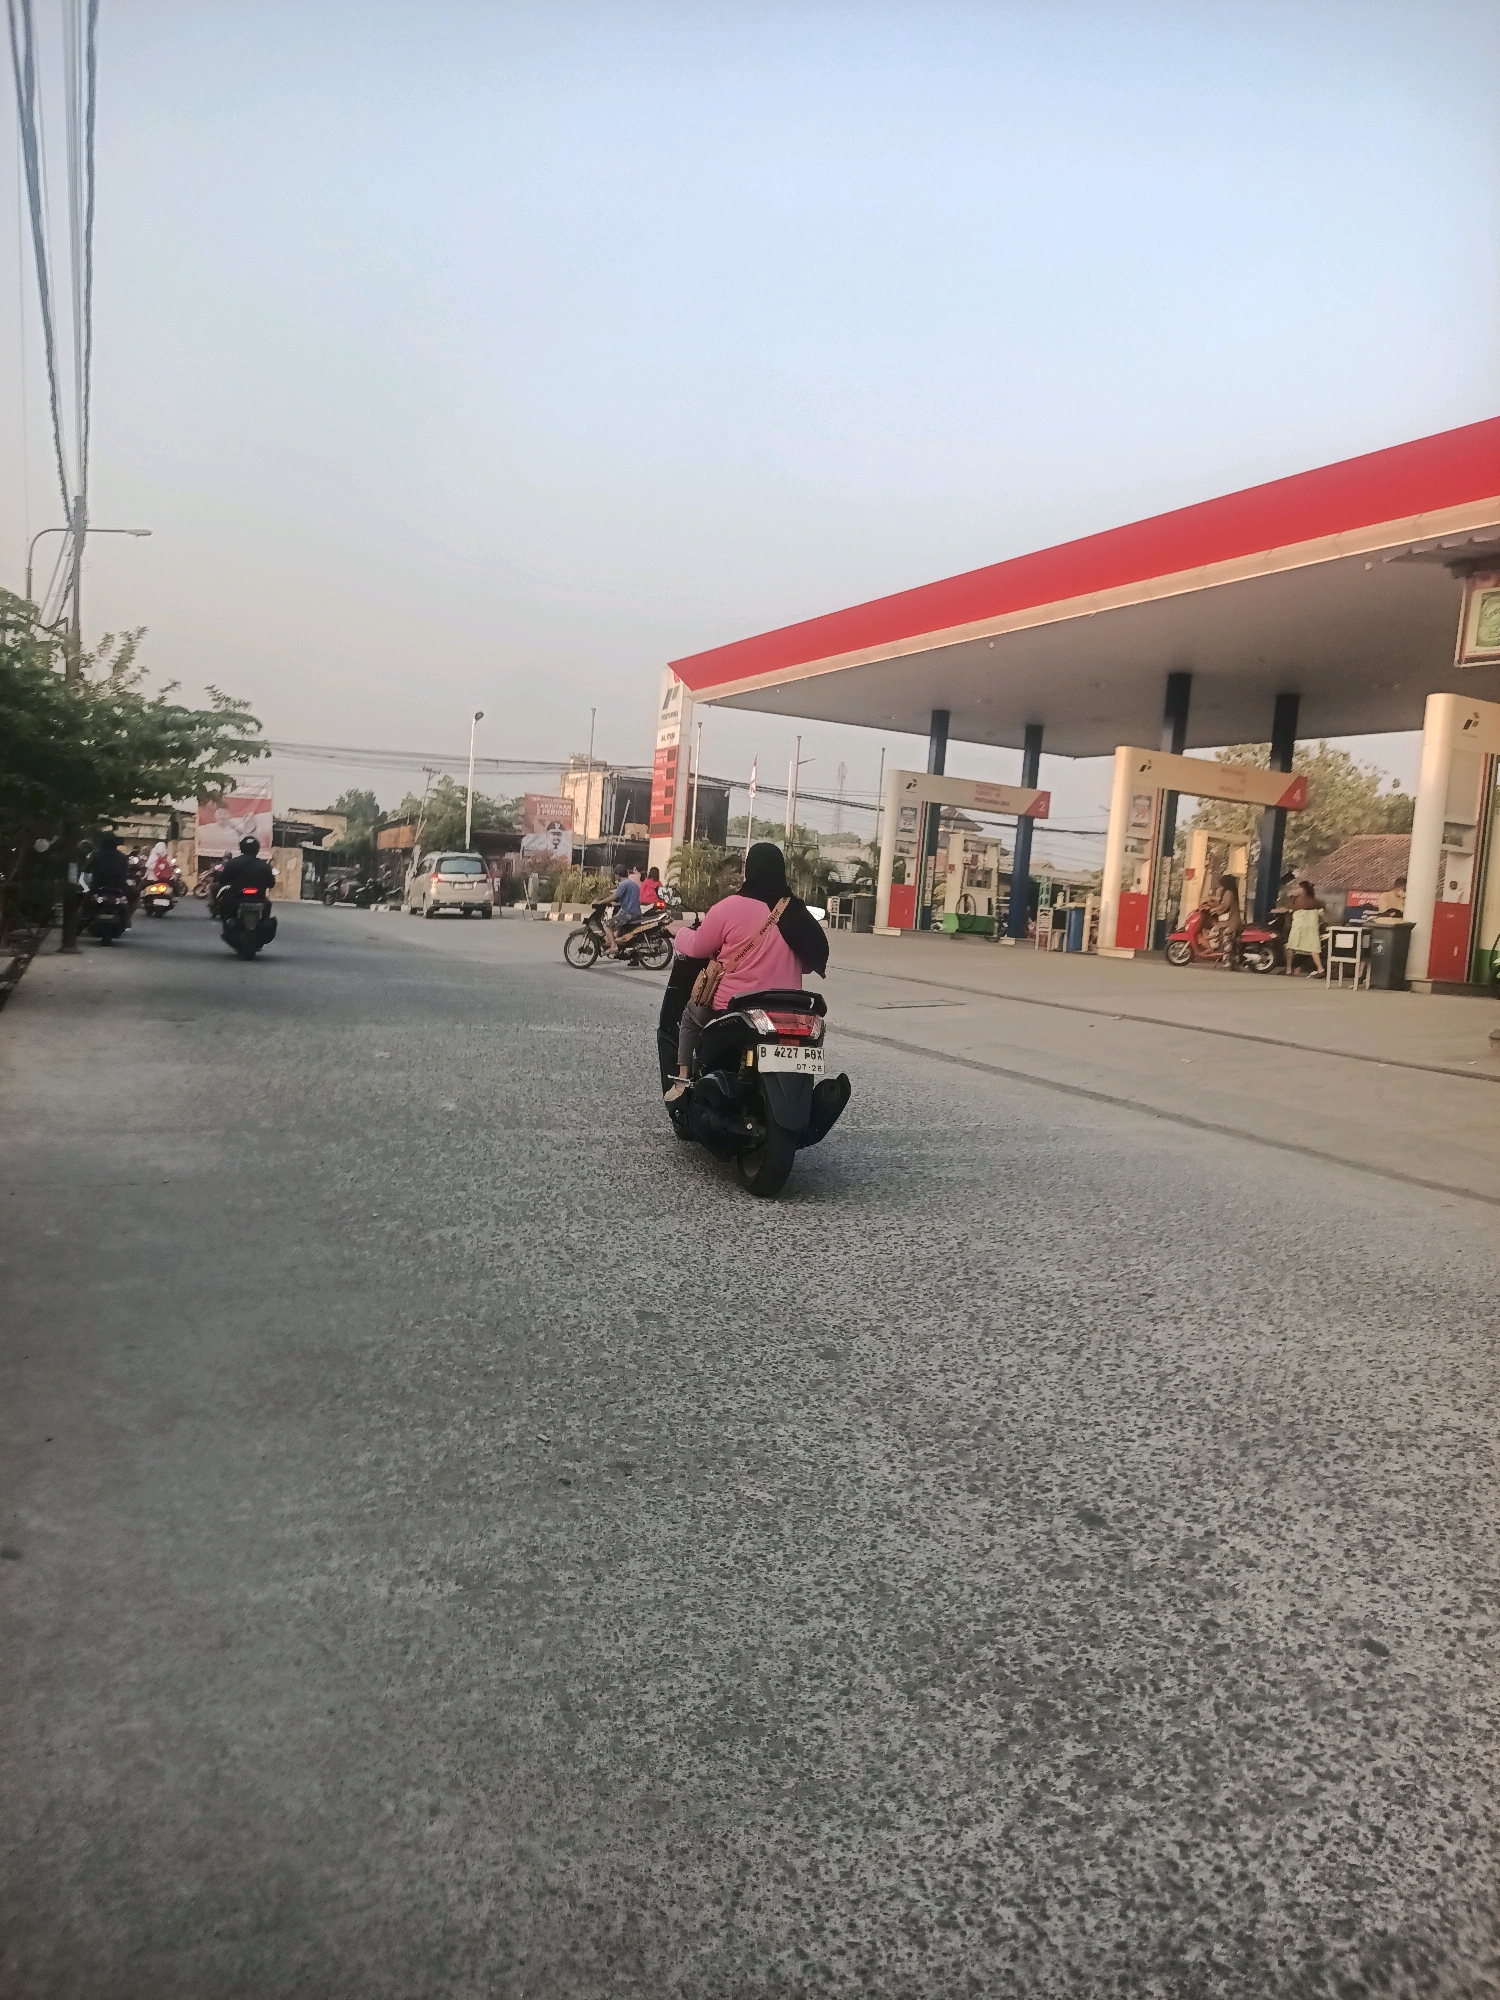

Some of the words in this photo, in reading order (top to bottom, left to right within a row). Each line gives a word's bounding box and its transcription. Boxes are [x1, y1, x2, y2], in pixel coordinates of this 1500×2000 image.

[1293, 788, 1301, 802] 4
[1038, 801, 1045, 812] 2
[760, 1047, 767, 1058] B
[774, 1046, 799, 1059] 4227
